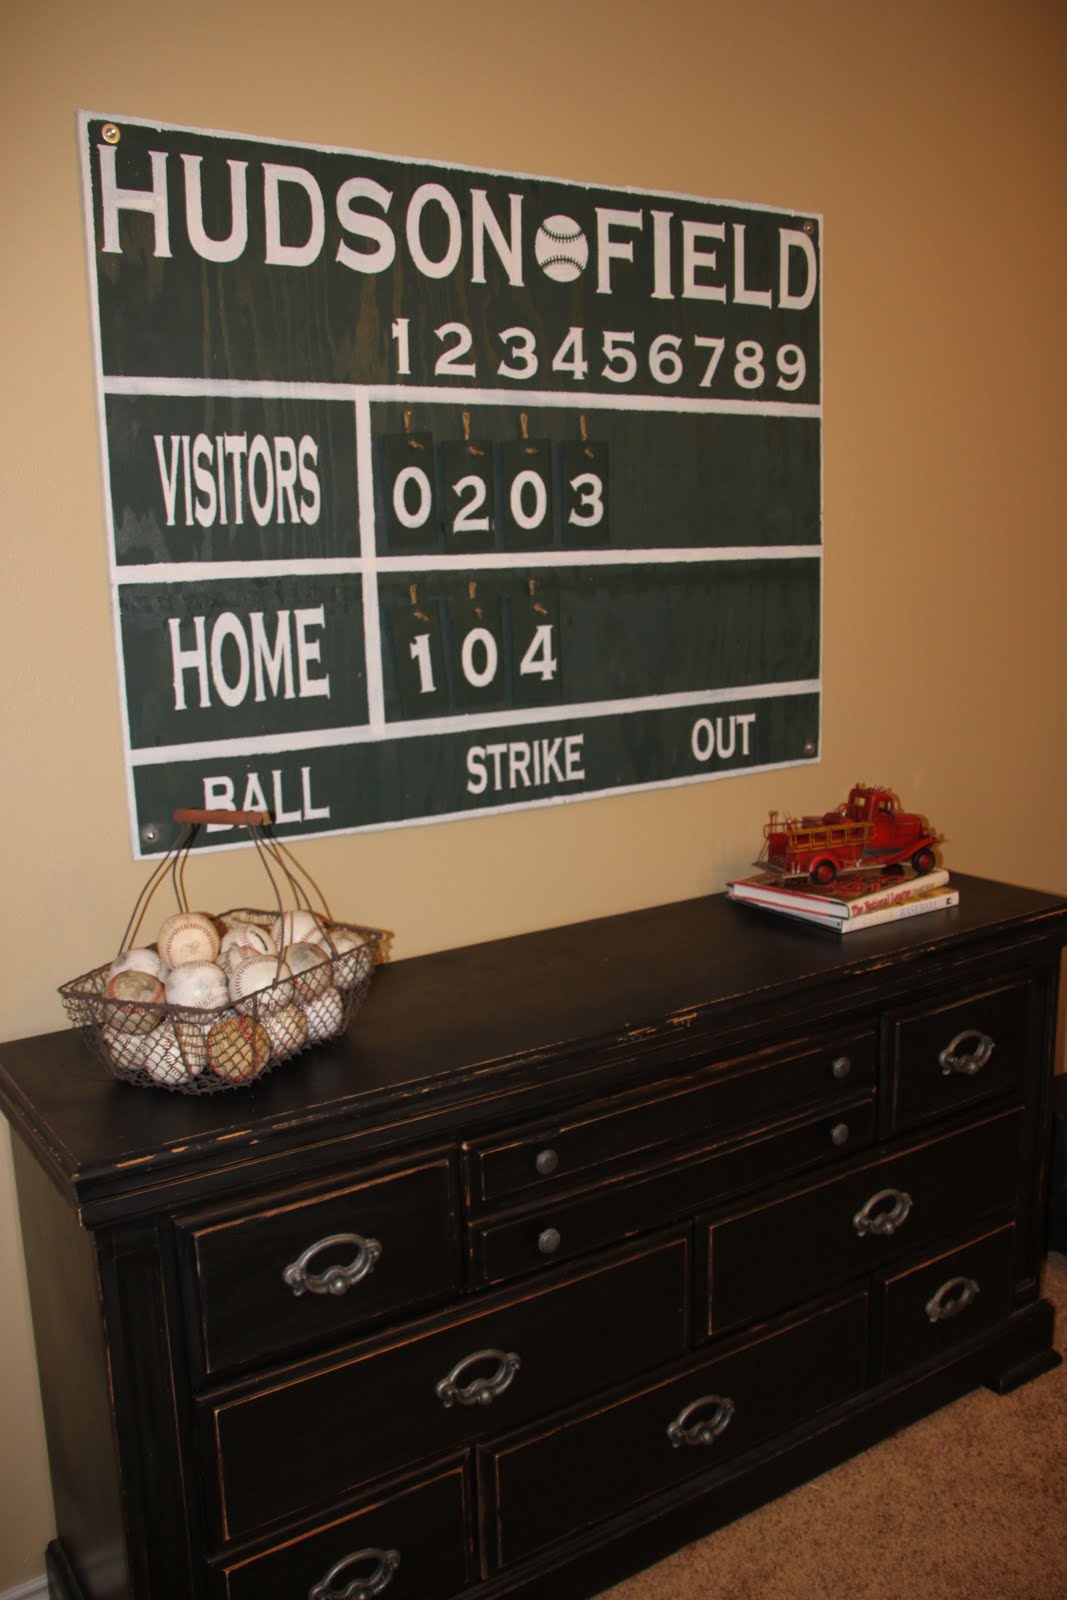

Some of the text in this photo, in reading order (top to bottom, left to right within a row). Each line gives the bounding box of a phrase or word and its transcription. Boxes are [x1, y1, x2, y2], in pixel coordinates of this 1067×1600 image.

[97, 144, 817, 310] HUDSON FIELD
[392, 318, 806, 391] 1 2 3 4 5 6 7 8 9
[153, 432, 604, 534] VISITORS 0 2 0 3
[168, 604, 557, 710] HOME 1 0 4
[203, 713, 756, 833] BALL STRIKE OUT
[851, 903, 863, 917] The
[864, 893, 890, 913] National
[890, 888, 912, 903] League
